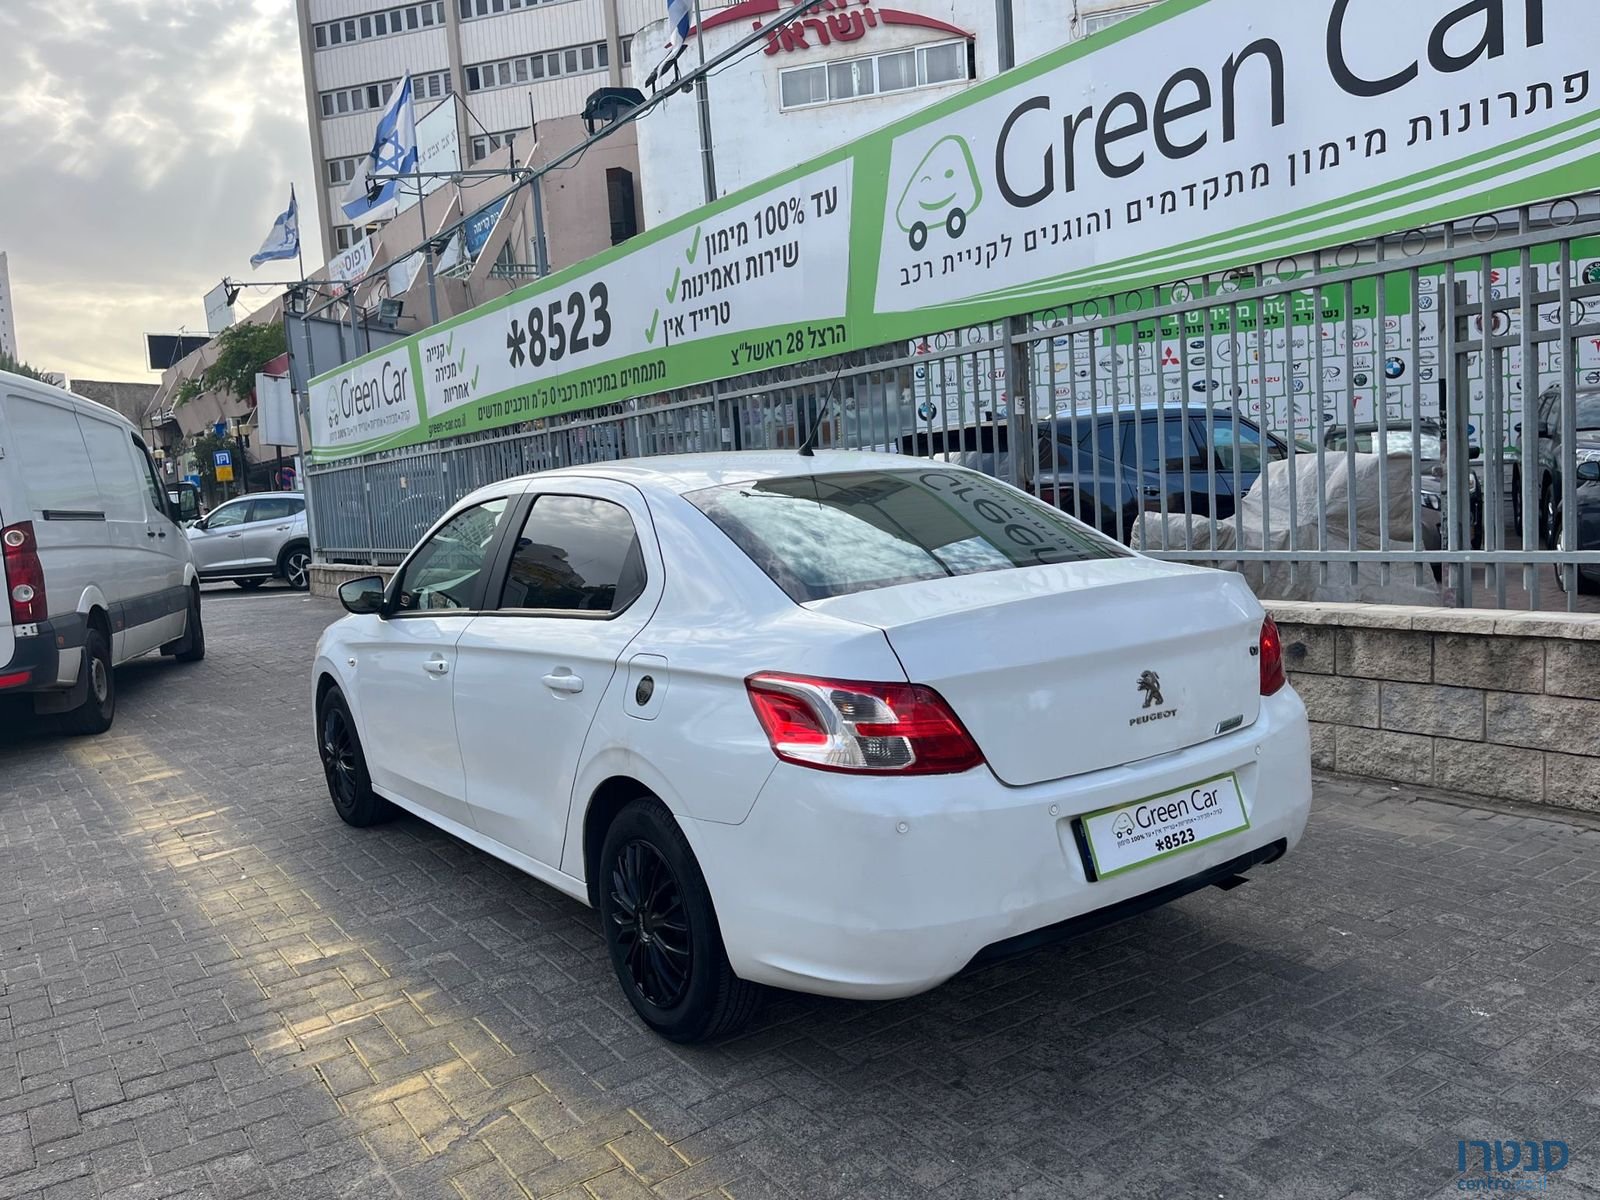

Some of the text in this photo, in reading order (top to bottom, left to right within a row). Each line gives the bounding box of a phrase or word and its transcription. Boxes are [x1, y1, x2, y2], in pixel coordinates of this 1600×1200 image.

[996, 37, 1286, 208] Green
[900, 69, 1590, 286] פתרונות מימון מתקדמים והוגנים לקניית רכב
[704, 186, 838, 266] עד 100% מימון
[680, 240, 800, 302] שירות ואמינות
[663, 299, 731, 347] טרייד אין
[1168, 311, 1199, 326] טב
[1209, 305, 1250, 321] מיר
[1303, 309, 1339, 321] נשר
[786, 331, 804, 354] 28
[807, 323, 846, 350] הרצל
[1340, 341, 1369, 349] TOTA
[1406, 336, 1435, 344] RAULT
[426, 343, 445, 363] קנייה
[435, 362, 457, 383] מכירה
[620, 360, 667, 388] מתמחים
[1251, 376, 1281, 385] ISZU
[340, 361, 408, 419] Green Car
[443, 382, 470, 404] אחריות
[558, 384, 578, 401] רכבי
[579, 374, 618, 398] במכירת
[477, 402, 502, 421] חדשים
[504, 395, 530, 415] ורכבים
[1129, 708, 1178, 727] PEUGEOT
[1135, 789, 1218, 829] Green Car
